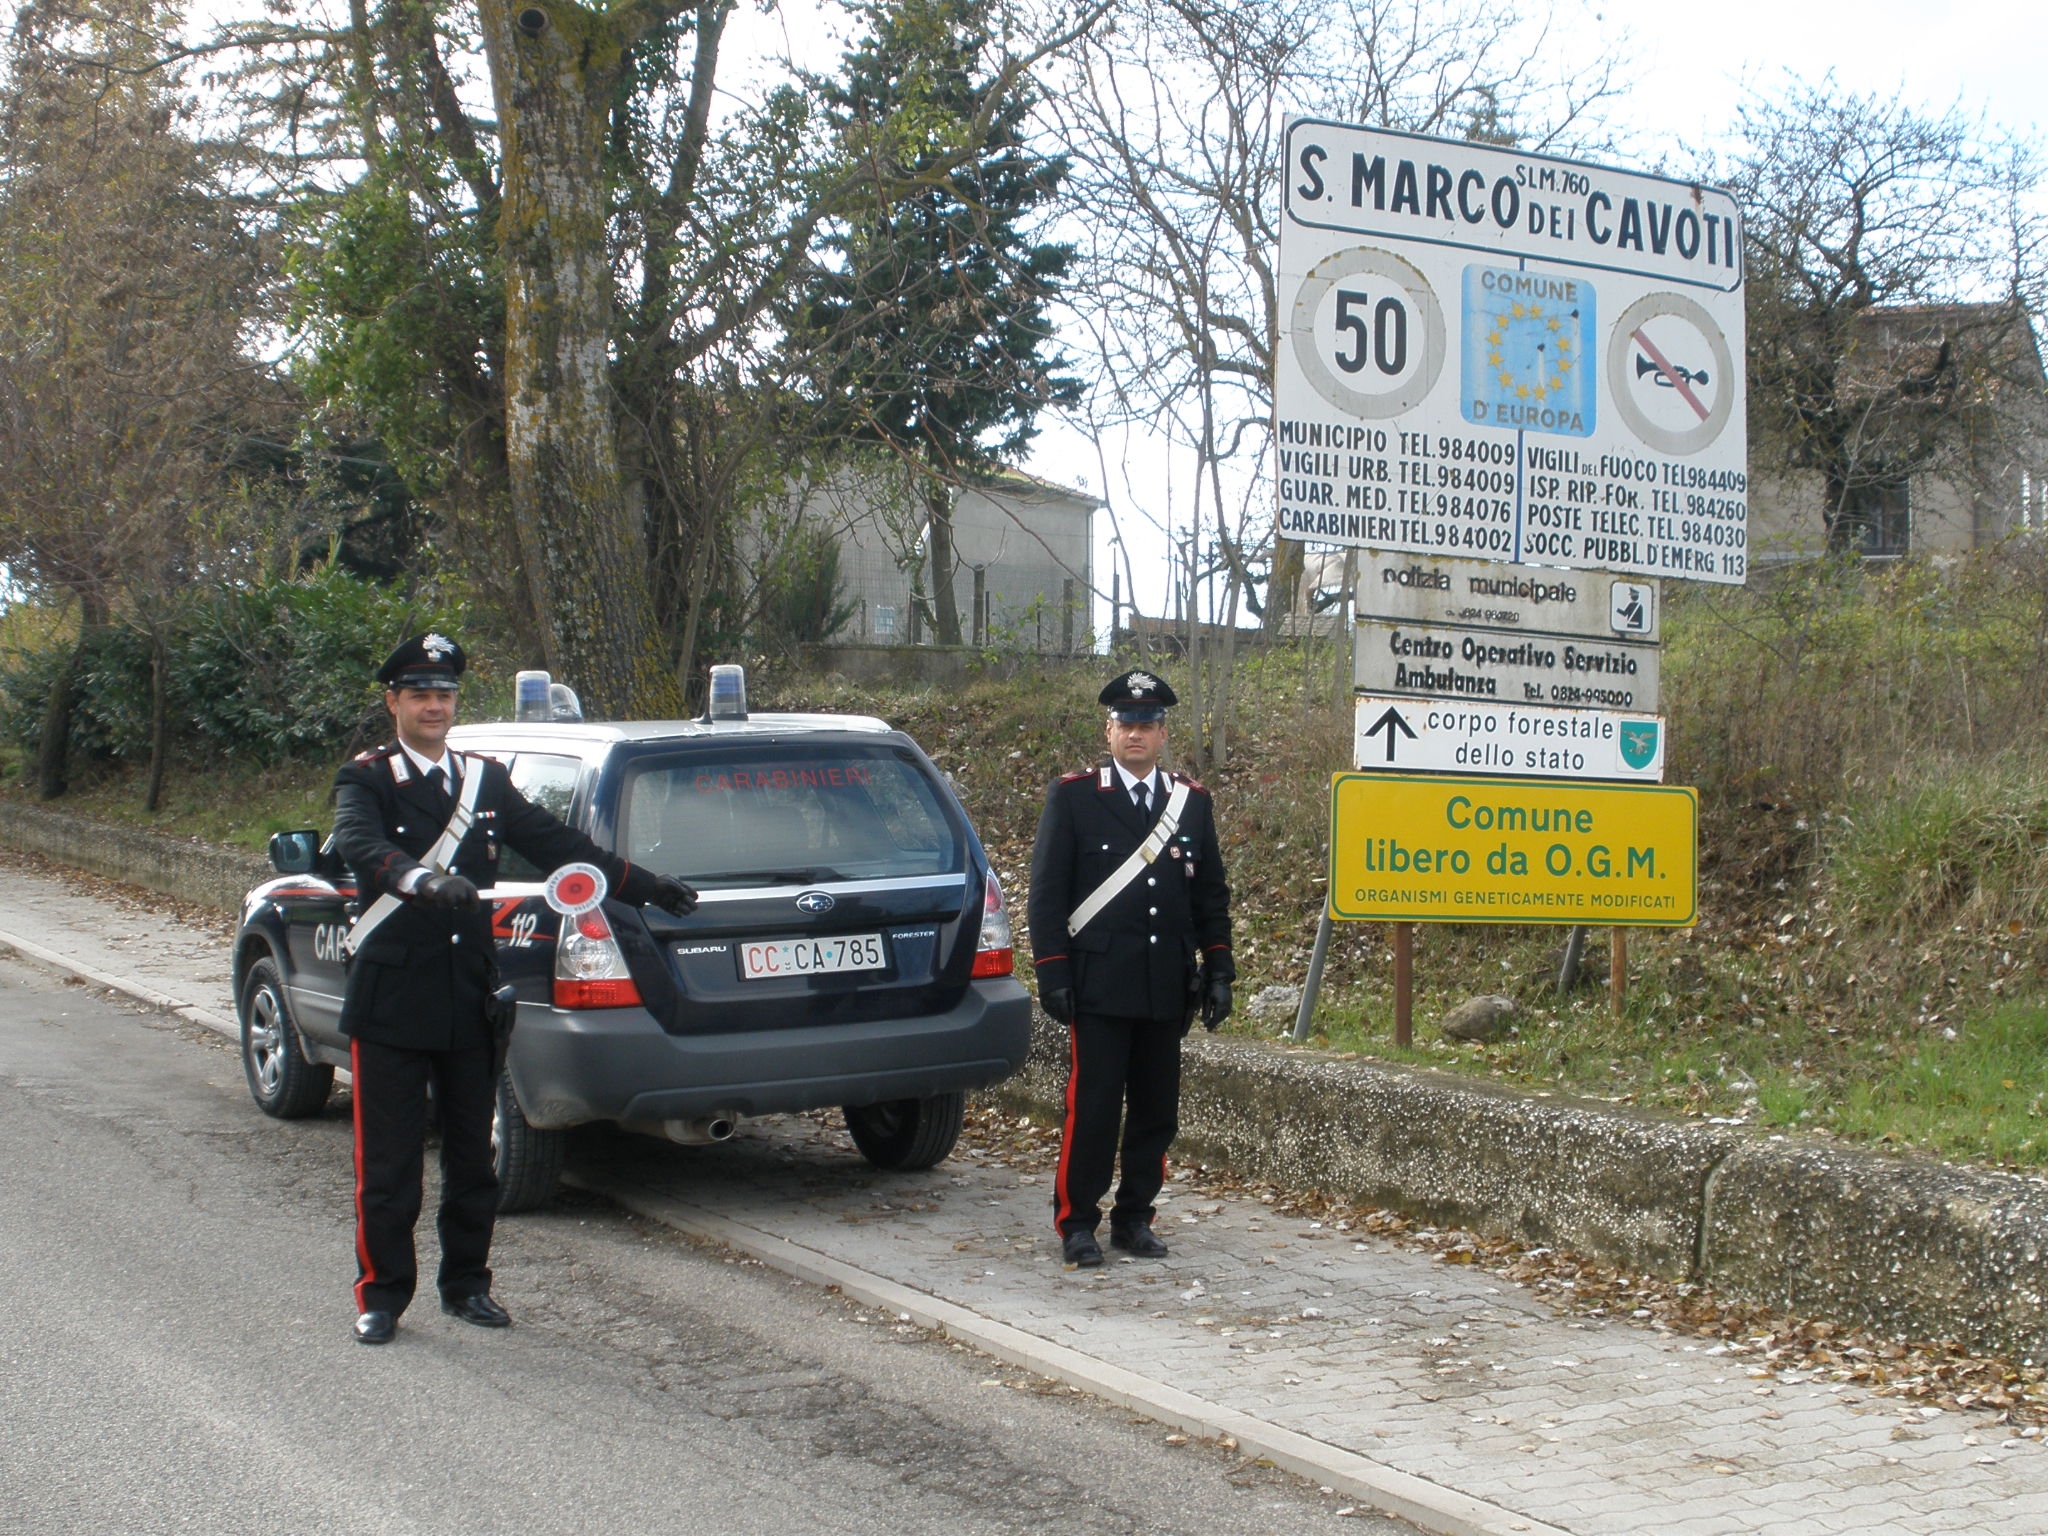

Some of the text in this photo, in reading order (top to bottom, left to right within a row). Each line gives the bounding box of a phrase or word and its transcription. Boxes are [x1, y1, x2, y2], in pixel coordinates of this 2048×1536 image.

[1298, 144, 1733, 268] S. MARCO DEI CAVOTI
[1481, 271, 1578, 302] COMUNE
[1335, 289, 1407, 375] 50
[1280, 421, 1387, 452] MUNICIPIO
[1280, 450, 1339, 478] VIGILI
[1349, 456, 1392, 483] URB.
[1527, 447, 1579, 474] VIGILI
[1582, 464, 1598, 477] DEL
[1600, 455, 1657, 483] FUOCO
[1280, 478, 1340, 507] GUAR.
[1346, 485, 1392, 512] MED.
[1530, 475, 1560, 500] ISP.
[1568, 480, 1597, 505] RIP.
[1279, 507, 1396, 542] CARABINIERI
[1528, 504, 1582, 531] POSTE
[1591, 510, 1643, 537] TELEC.
[1524, 533, 1576, 559] SOCC.
[1722, 553, 1745, 577] 113
[1470, 576, 1577, 604] municipale
[1390, 631, 1637, 675] Centro Operativo Servizio
[1394, 663, 1497, 695] Ambulanza
[1523, 683, 1544, 700] Tel.
[1428, 711, 1613, 739] corpo forestale
[1456, 742, 1584, 770] dello stato
[695, 767, 872, 795] CARABINIERI
[1446, 796, 1594, 833] Comune
[1365, 838, 1667, 880] libero da O.G.M.
[1355, 888, 1676, 909] ORGANISMI GENETICAMENTE MODIFICATI
[508, 912, 538, 948] 112
[891, 930, 936, 940] FORESTER
[676, 945, 728, 956] SUBARU
